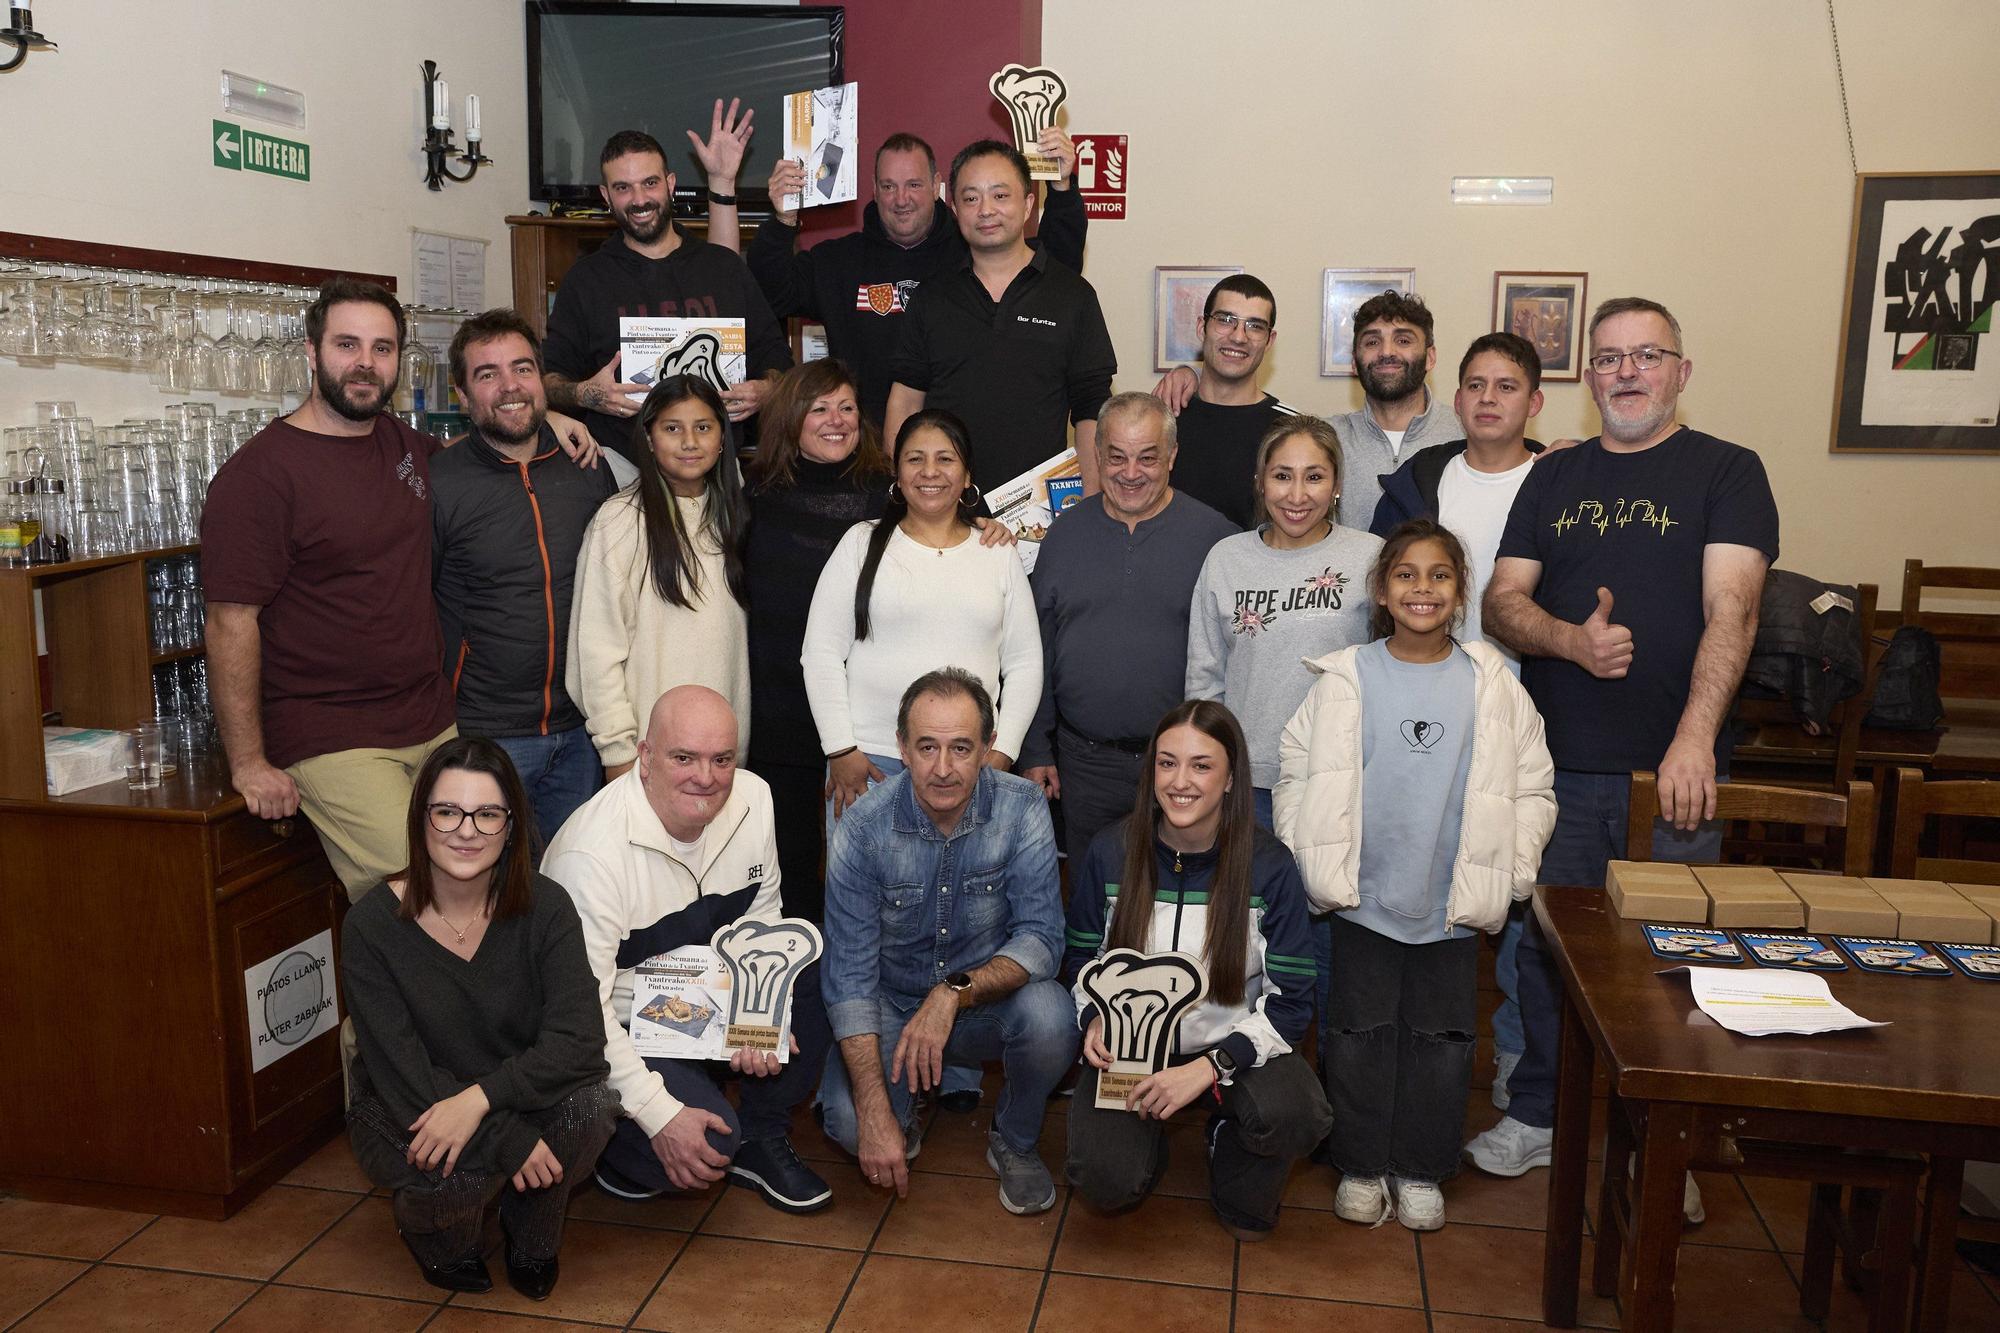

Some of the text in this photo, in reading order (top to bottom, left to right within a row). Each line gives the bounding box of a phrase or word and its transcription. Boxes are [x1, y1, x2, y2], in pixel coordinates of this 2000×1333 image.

[247, 136, 306, 175] IRTEERA
[1084, 202, 1122, 212] TINTOR
[700, 343, 708, 354] 3
[721, 343, 744, 351] ESTA
[1051, 480, 1082, 490] TXANTRE
[1235, 587, 1343, 612] PEPE JEANS
[1648, 925, 1725, 935] TXANTREA
[1741, 933, 1818, 942] TXANTREA
[1840, 937, 1918, 946] TXANTREA
[787, 939, 796, 952] 2
[1942, 943, 2000, 951] TXANTR
[671, 955, 700, 964] Semana
[644, 960, 668, 968] Pintxo
[680, 962, 709, 971] Txantrea
[257, 956, 327, 1000] PLATOS LLANOS
[643, 975, 685, 984] Txantreako
[648, 983, 669, 991] Pintxo
[1169, 977, 1178, 992] 1
[258, 996, 333, 1046] PLATER ZABALAK
